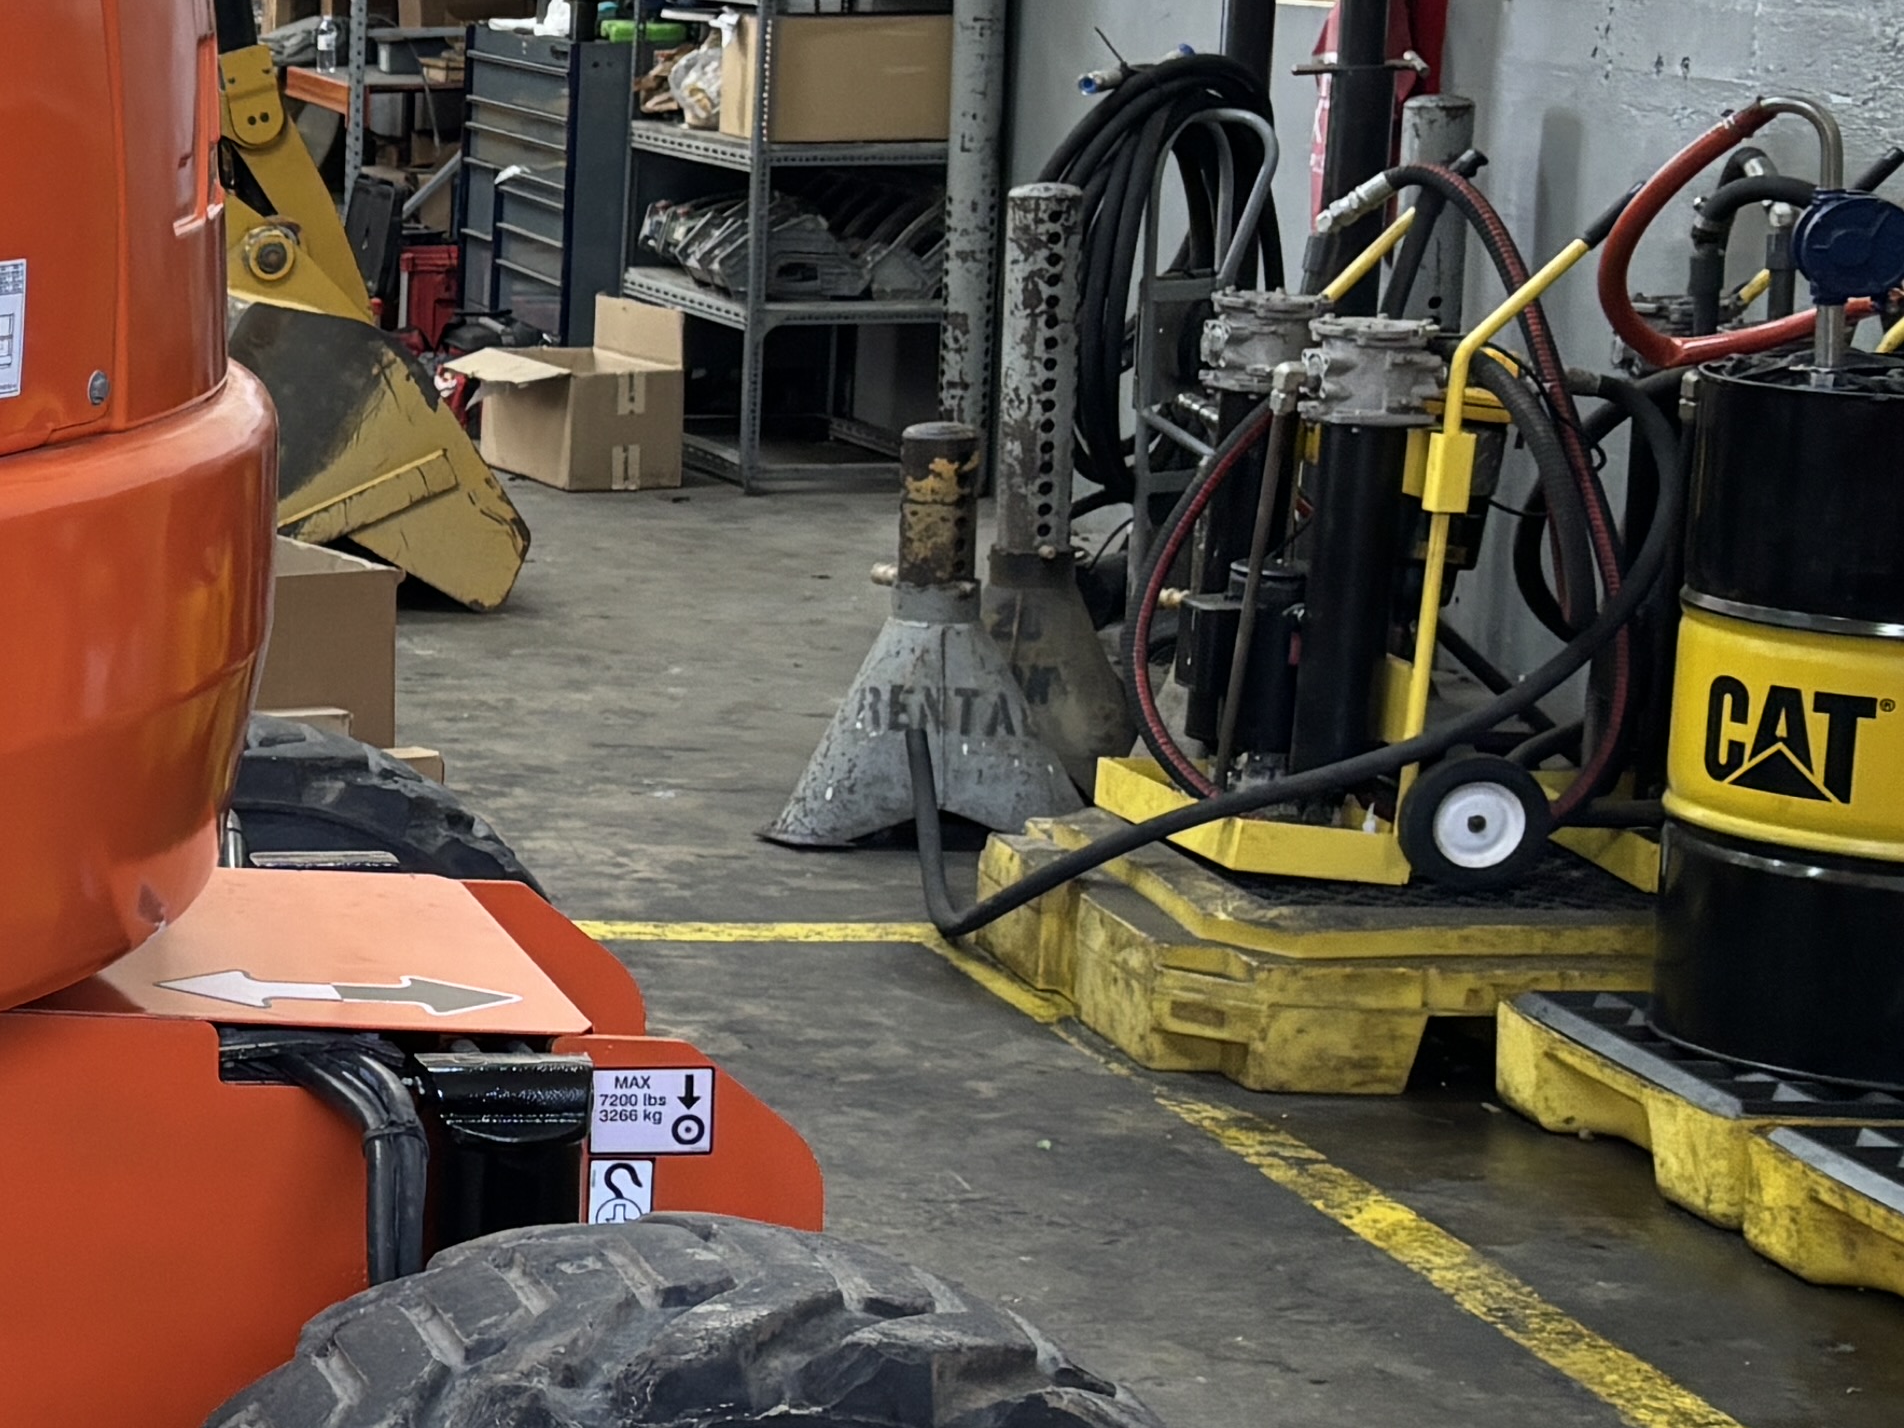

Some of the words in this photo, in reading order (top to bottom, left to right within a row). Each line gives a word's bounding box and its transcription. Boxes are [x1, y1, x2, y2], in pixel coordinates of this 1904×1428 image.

[1704, 674, 1879, 805] CAT
[614, 1075, 651, 1090] MAX
[599, 1093, 638, 1107] 7200
[643, 1093, 667, 1106] lbs
[599, 1109, 638, 1122] 3266
[643, 1109, 663, 1125] kg
